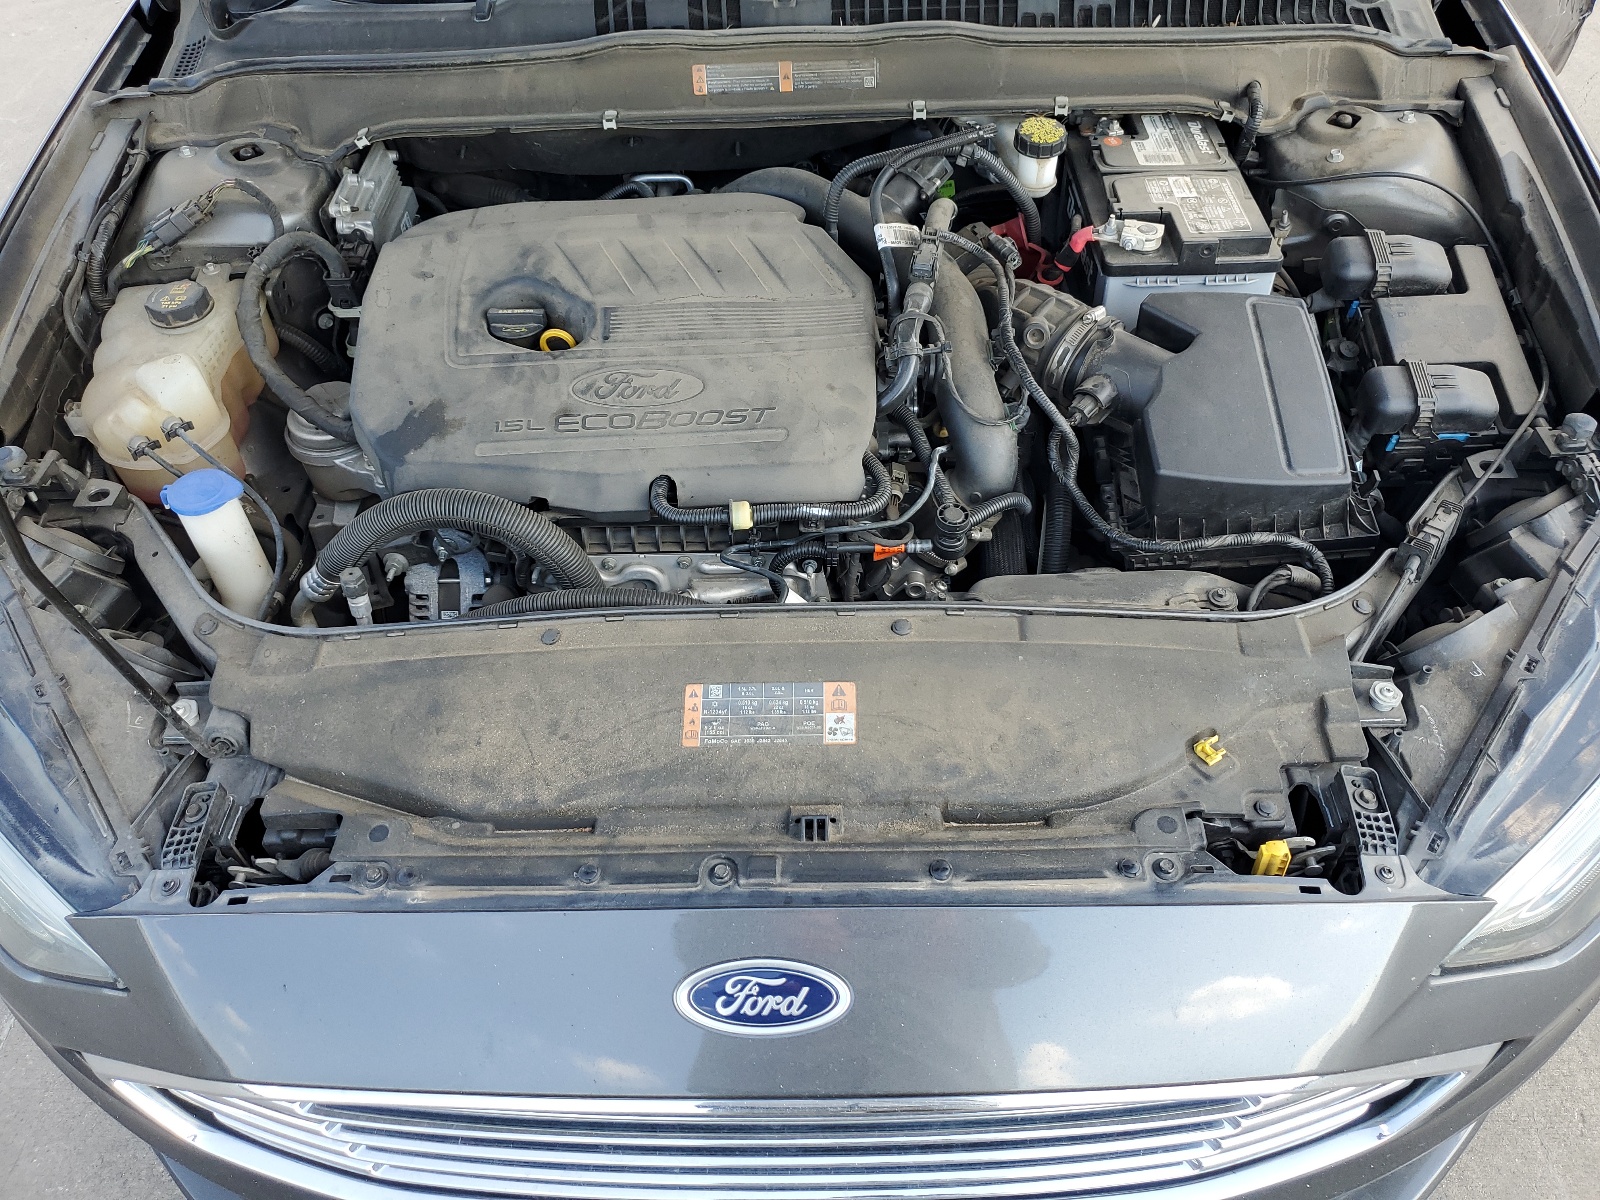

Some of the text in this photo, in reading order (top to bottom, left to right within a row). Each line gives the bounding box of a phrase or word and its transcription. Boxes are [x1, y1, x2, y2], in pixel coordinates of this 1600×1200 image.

[1187, 121, 1214, 154] Duralast
[594, 371, 682, 400] Ford
[495, 406, 776, 433] 1.5L ECOBOOST
[715, 975, 811, 1016] Ford
